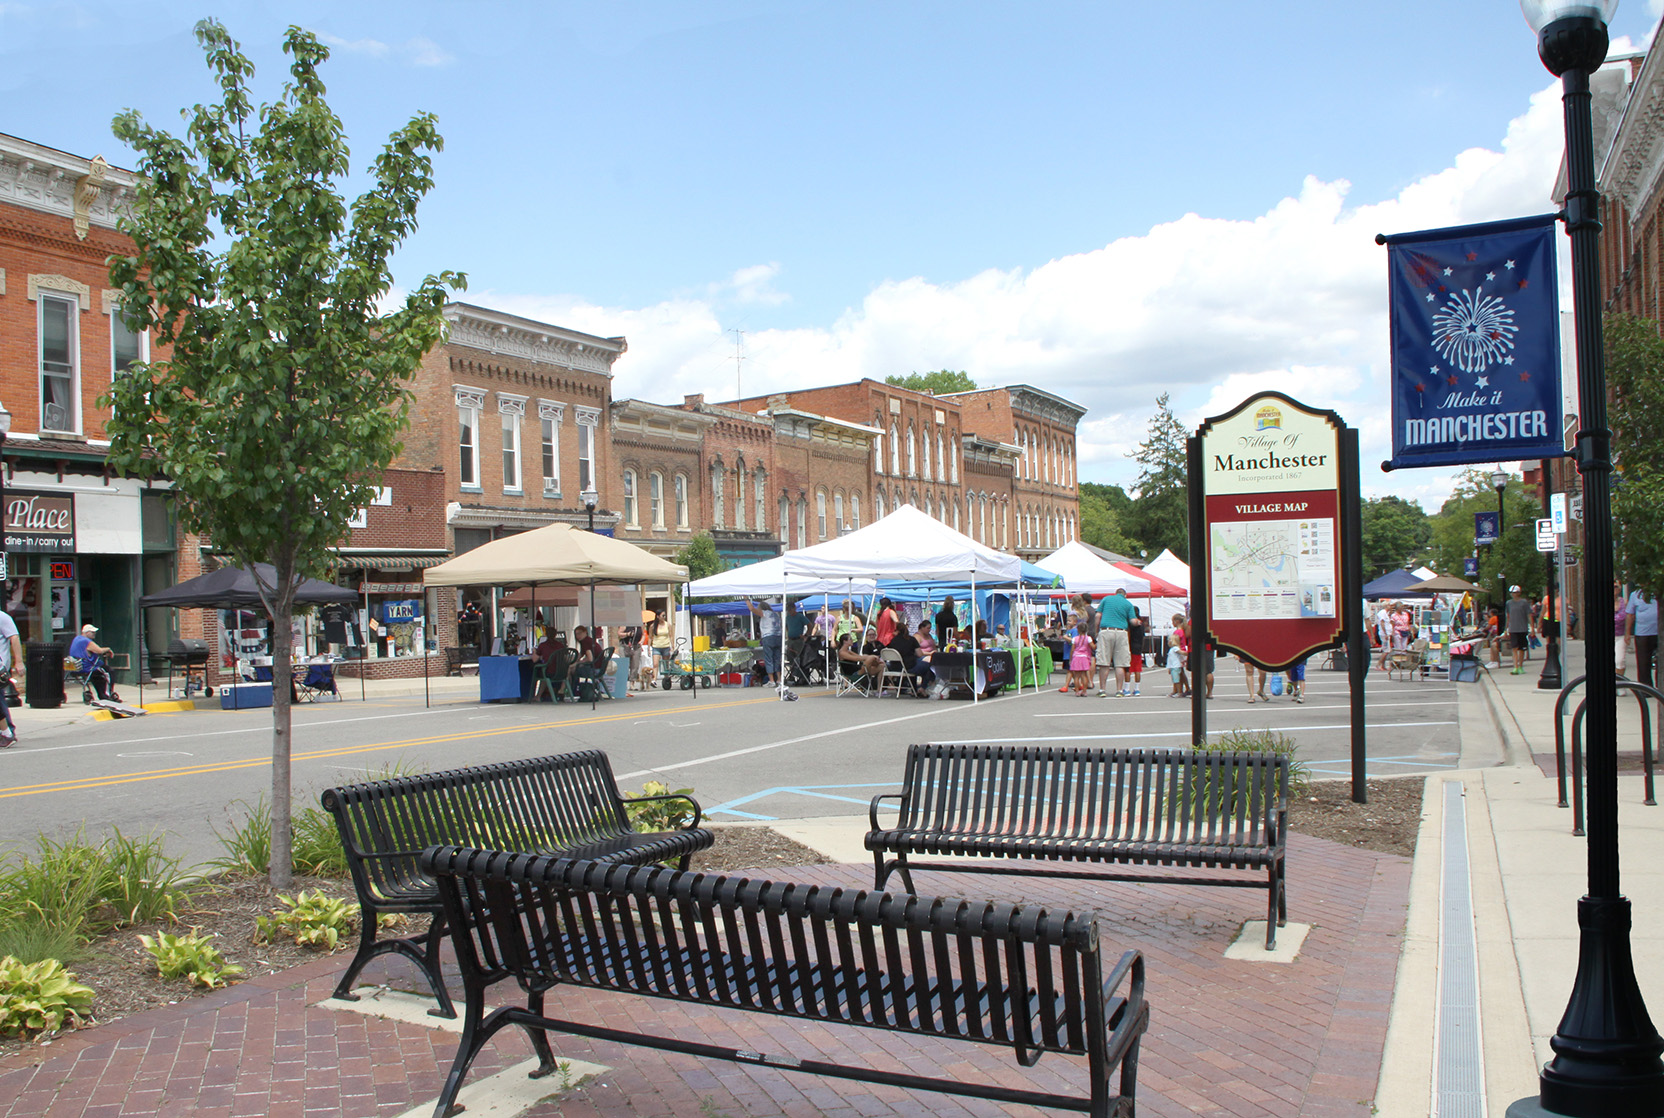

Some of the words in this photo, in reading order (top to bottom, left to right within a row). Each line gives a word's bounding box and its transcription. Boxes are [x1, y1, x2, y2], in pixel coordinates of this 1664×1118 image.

[1437, 391, 1487, 410] Make
[1490, 390, 1503, 405] it
[1405, 410, 1548, 446] MANCHESTER
[1238, 435, 1278, 451] Village
[1283, 433, 1303, 450] Of
[1214, 451, 1327, 472] Manchester
[1238, 472, 1283, 482] Incorporated
[8, 495, 69, 529] Place
[1235, 503, 1282, 514] VILLAGE
[1284, 502, 1309, 512] MAP
[61, 537, 73, 545] out
[390, 606, 413, 617] YARN
